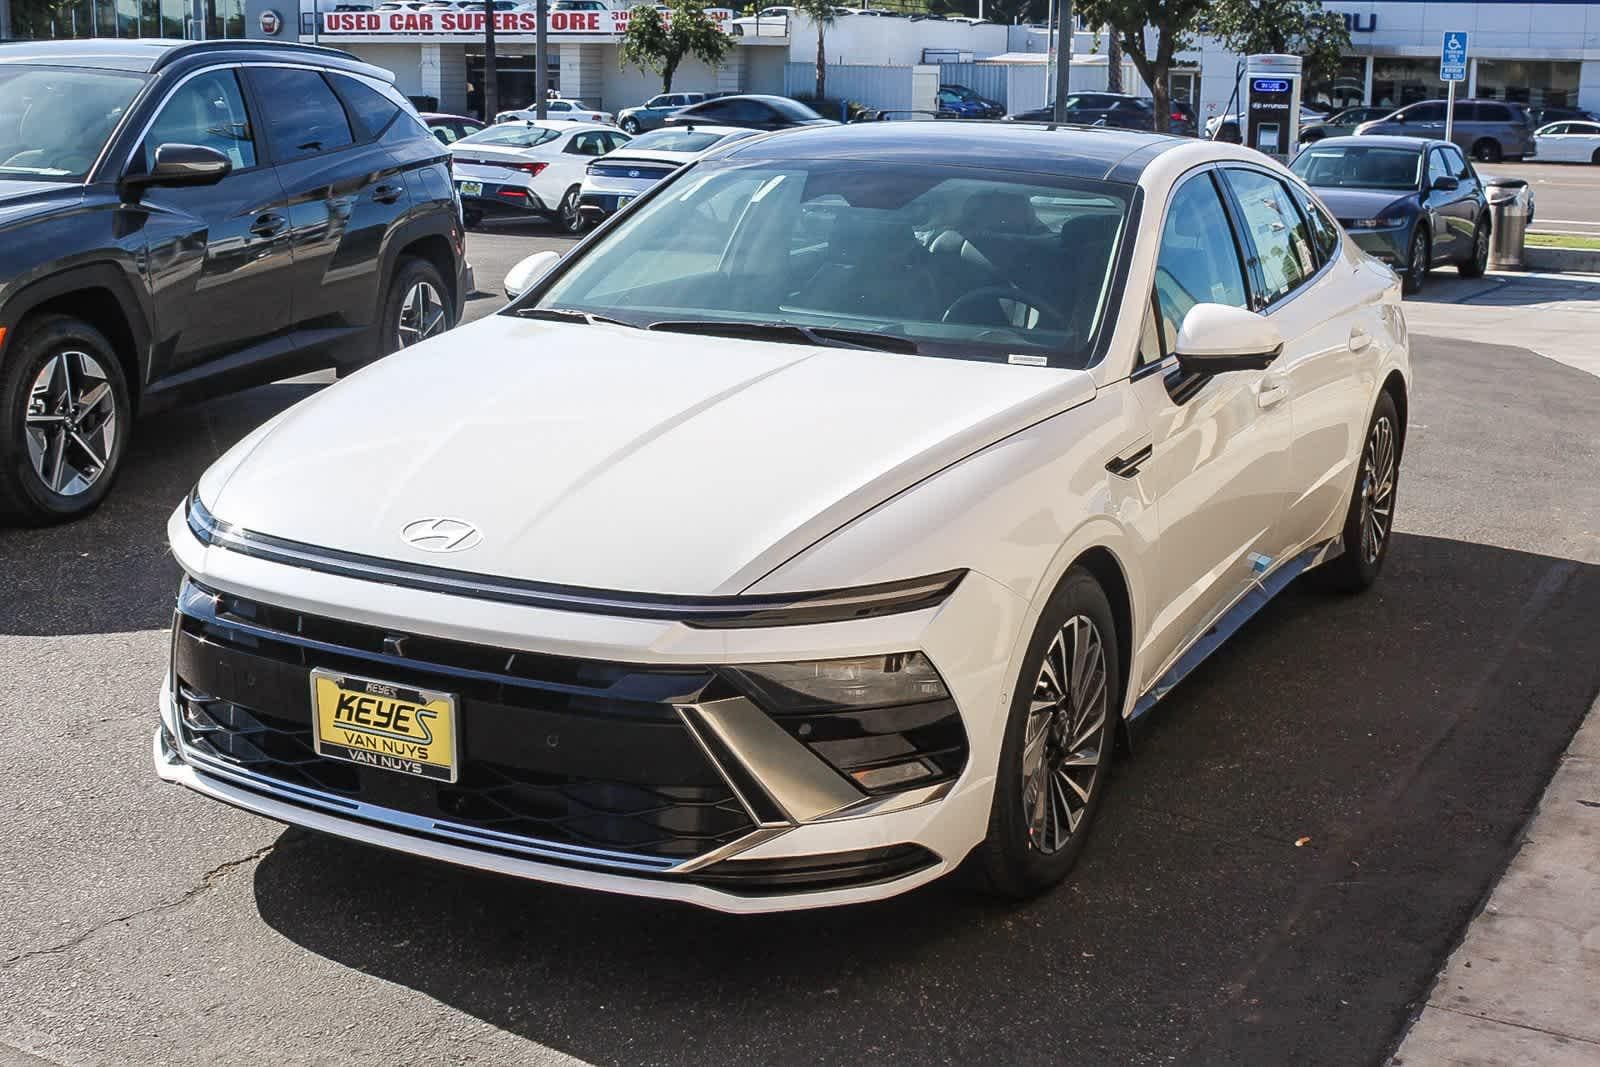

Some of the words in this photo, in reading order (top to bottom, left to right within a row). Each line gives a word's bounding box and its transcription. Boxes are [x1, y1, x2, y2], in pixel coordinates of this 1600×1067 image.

[327, 13, 381, 31] USED
[389, 13, 433, 31] CAR
[441, 13, 600, 31] SUPERSORE
[365, 682, 399, 699] KEYES
[334, 693, 438, 745] KEYES
[343, 731, 377, 750] VAN
[382, 742, 429, 760] NUYS
[348, 749, 378, 765] VAN
[381, 756, 423, 774] NUYS
